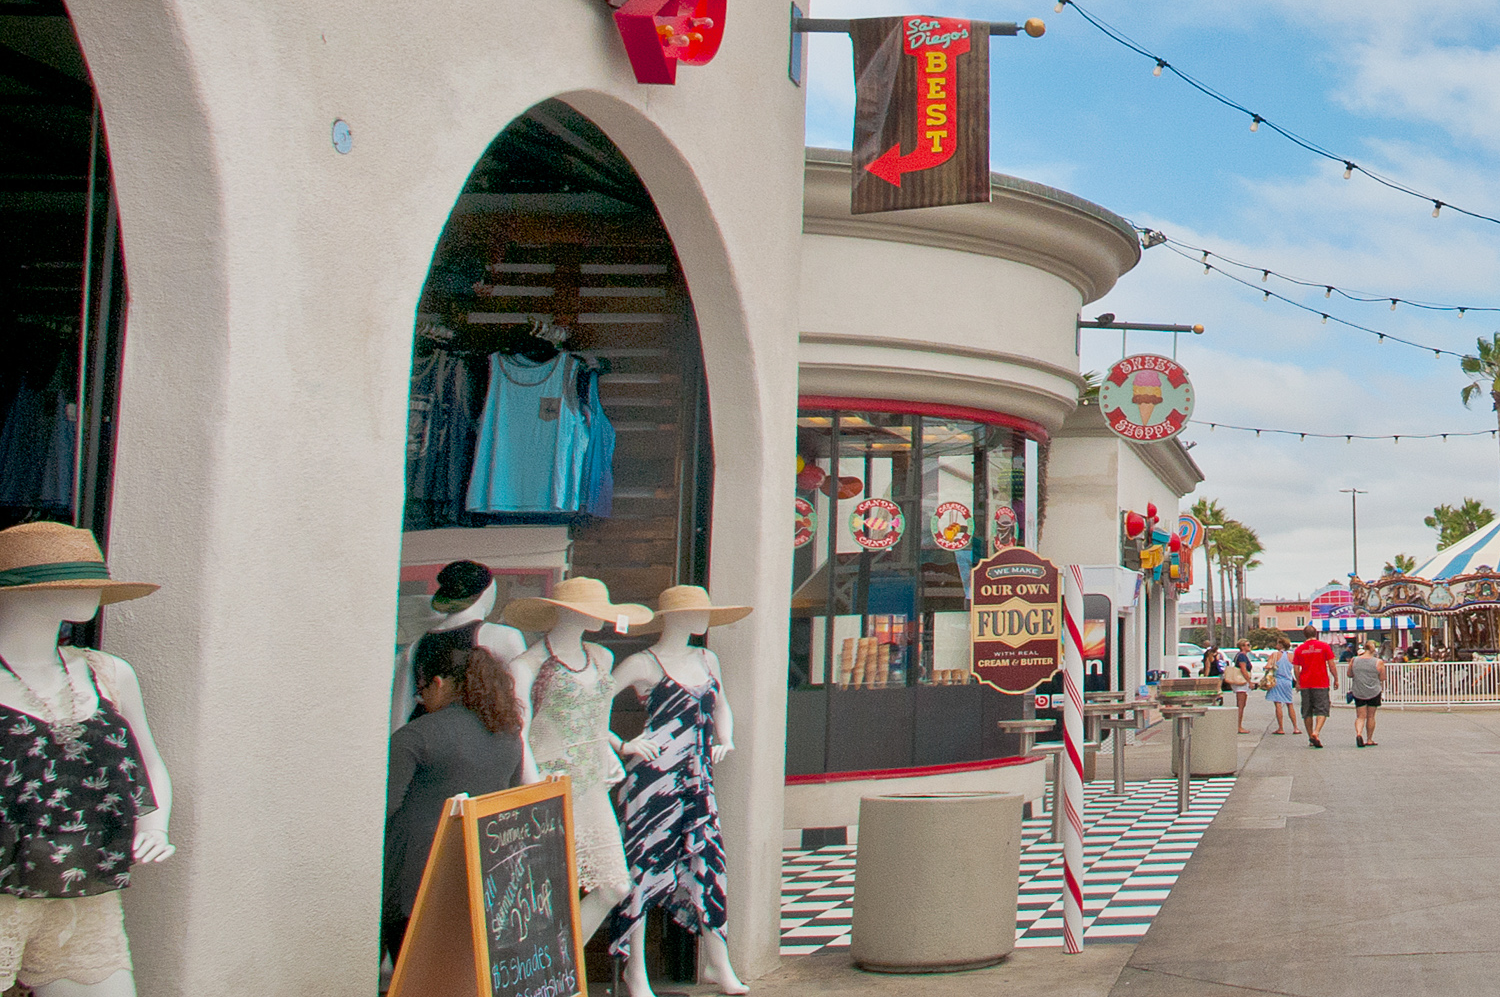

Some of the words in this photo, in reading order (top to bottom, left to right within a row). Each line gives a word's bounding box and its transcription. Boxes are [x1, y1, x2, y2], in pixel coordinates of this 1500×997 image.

[906, 19, 940, 35] San
[908, 24, 969, 49] Diego's
[925, 51, 948, 153] BEST
[1120, 357, 1177, 374] SWEET
[1115, 419, 1175, 439] SHOPPE
[859, 500, 896, 511] CANDY
[859, 536, 893, 547] CANDY
[980, 584, 1013, 596] OUR
[1015, 583, 1050, 595] OWN
[977, 609, 1055, 637] FUDGE
[1190, 617, 1223, 625] PIZA
[978, 659, 1010, 667] CREAM
[1011, 658, 1019, 666] &
[1020, 657, 1054, 666] BUTTER
[510, 944, 552, 985] Shades
